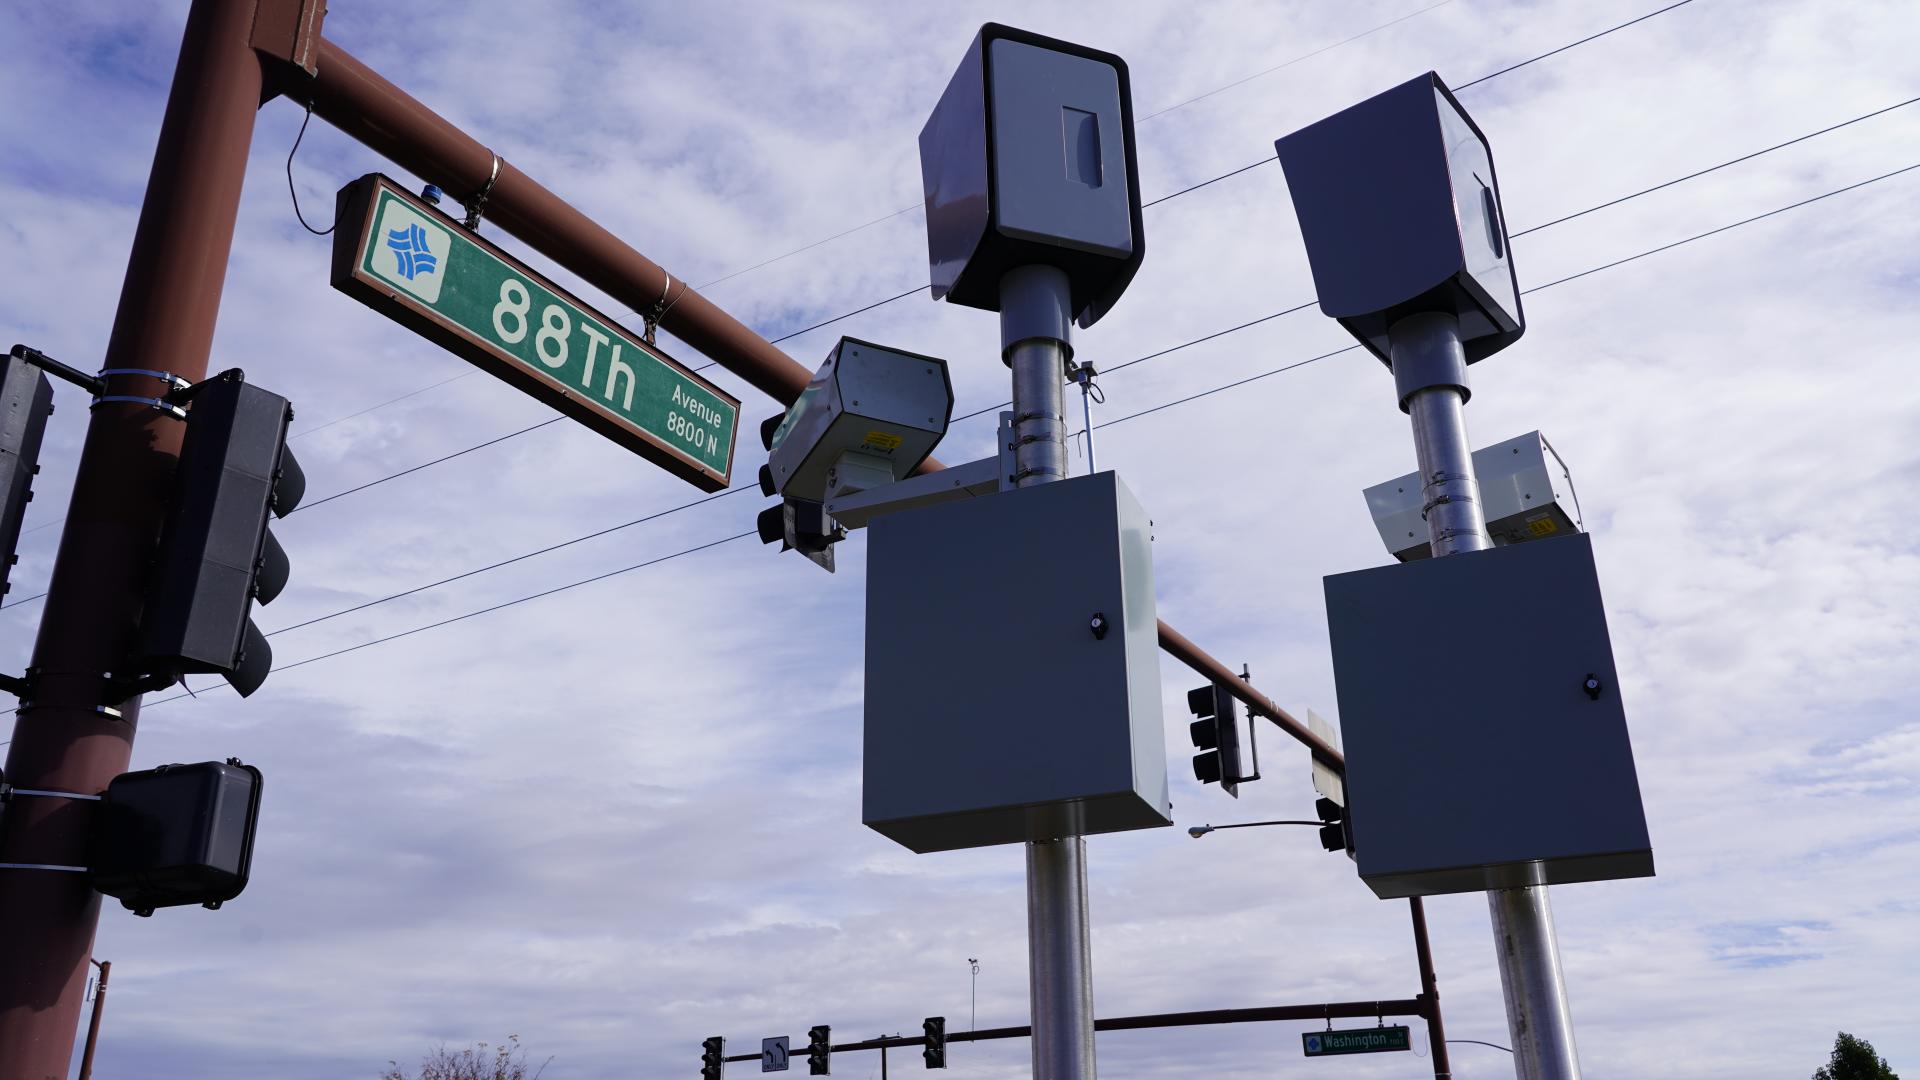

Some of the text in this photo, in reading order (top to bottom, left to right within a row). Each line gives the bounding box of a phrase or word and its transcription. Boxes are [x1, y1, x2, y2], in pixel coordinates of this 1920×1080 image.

[492, 278, 636, 412] 88Th
[671, 384, 722, 429] Avenue
[667, 411, 718, 456] 8800 N
[1324, 1033, 1387, 1050] Washington
